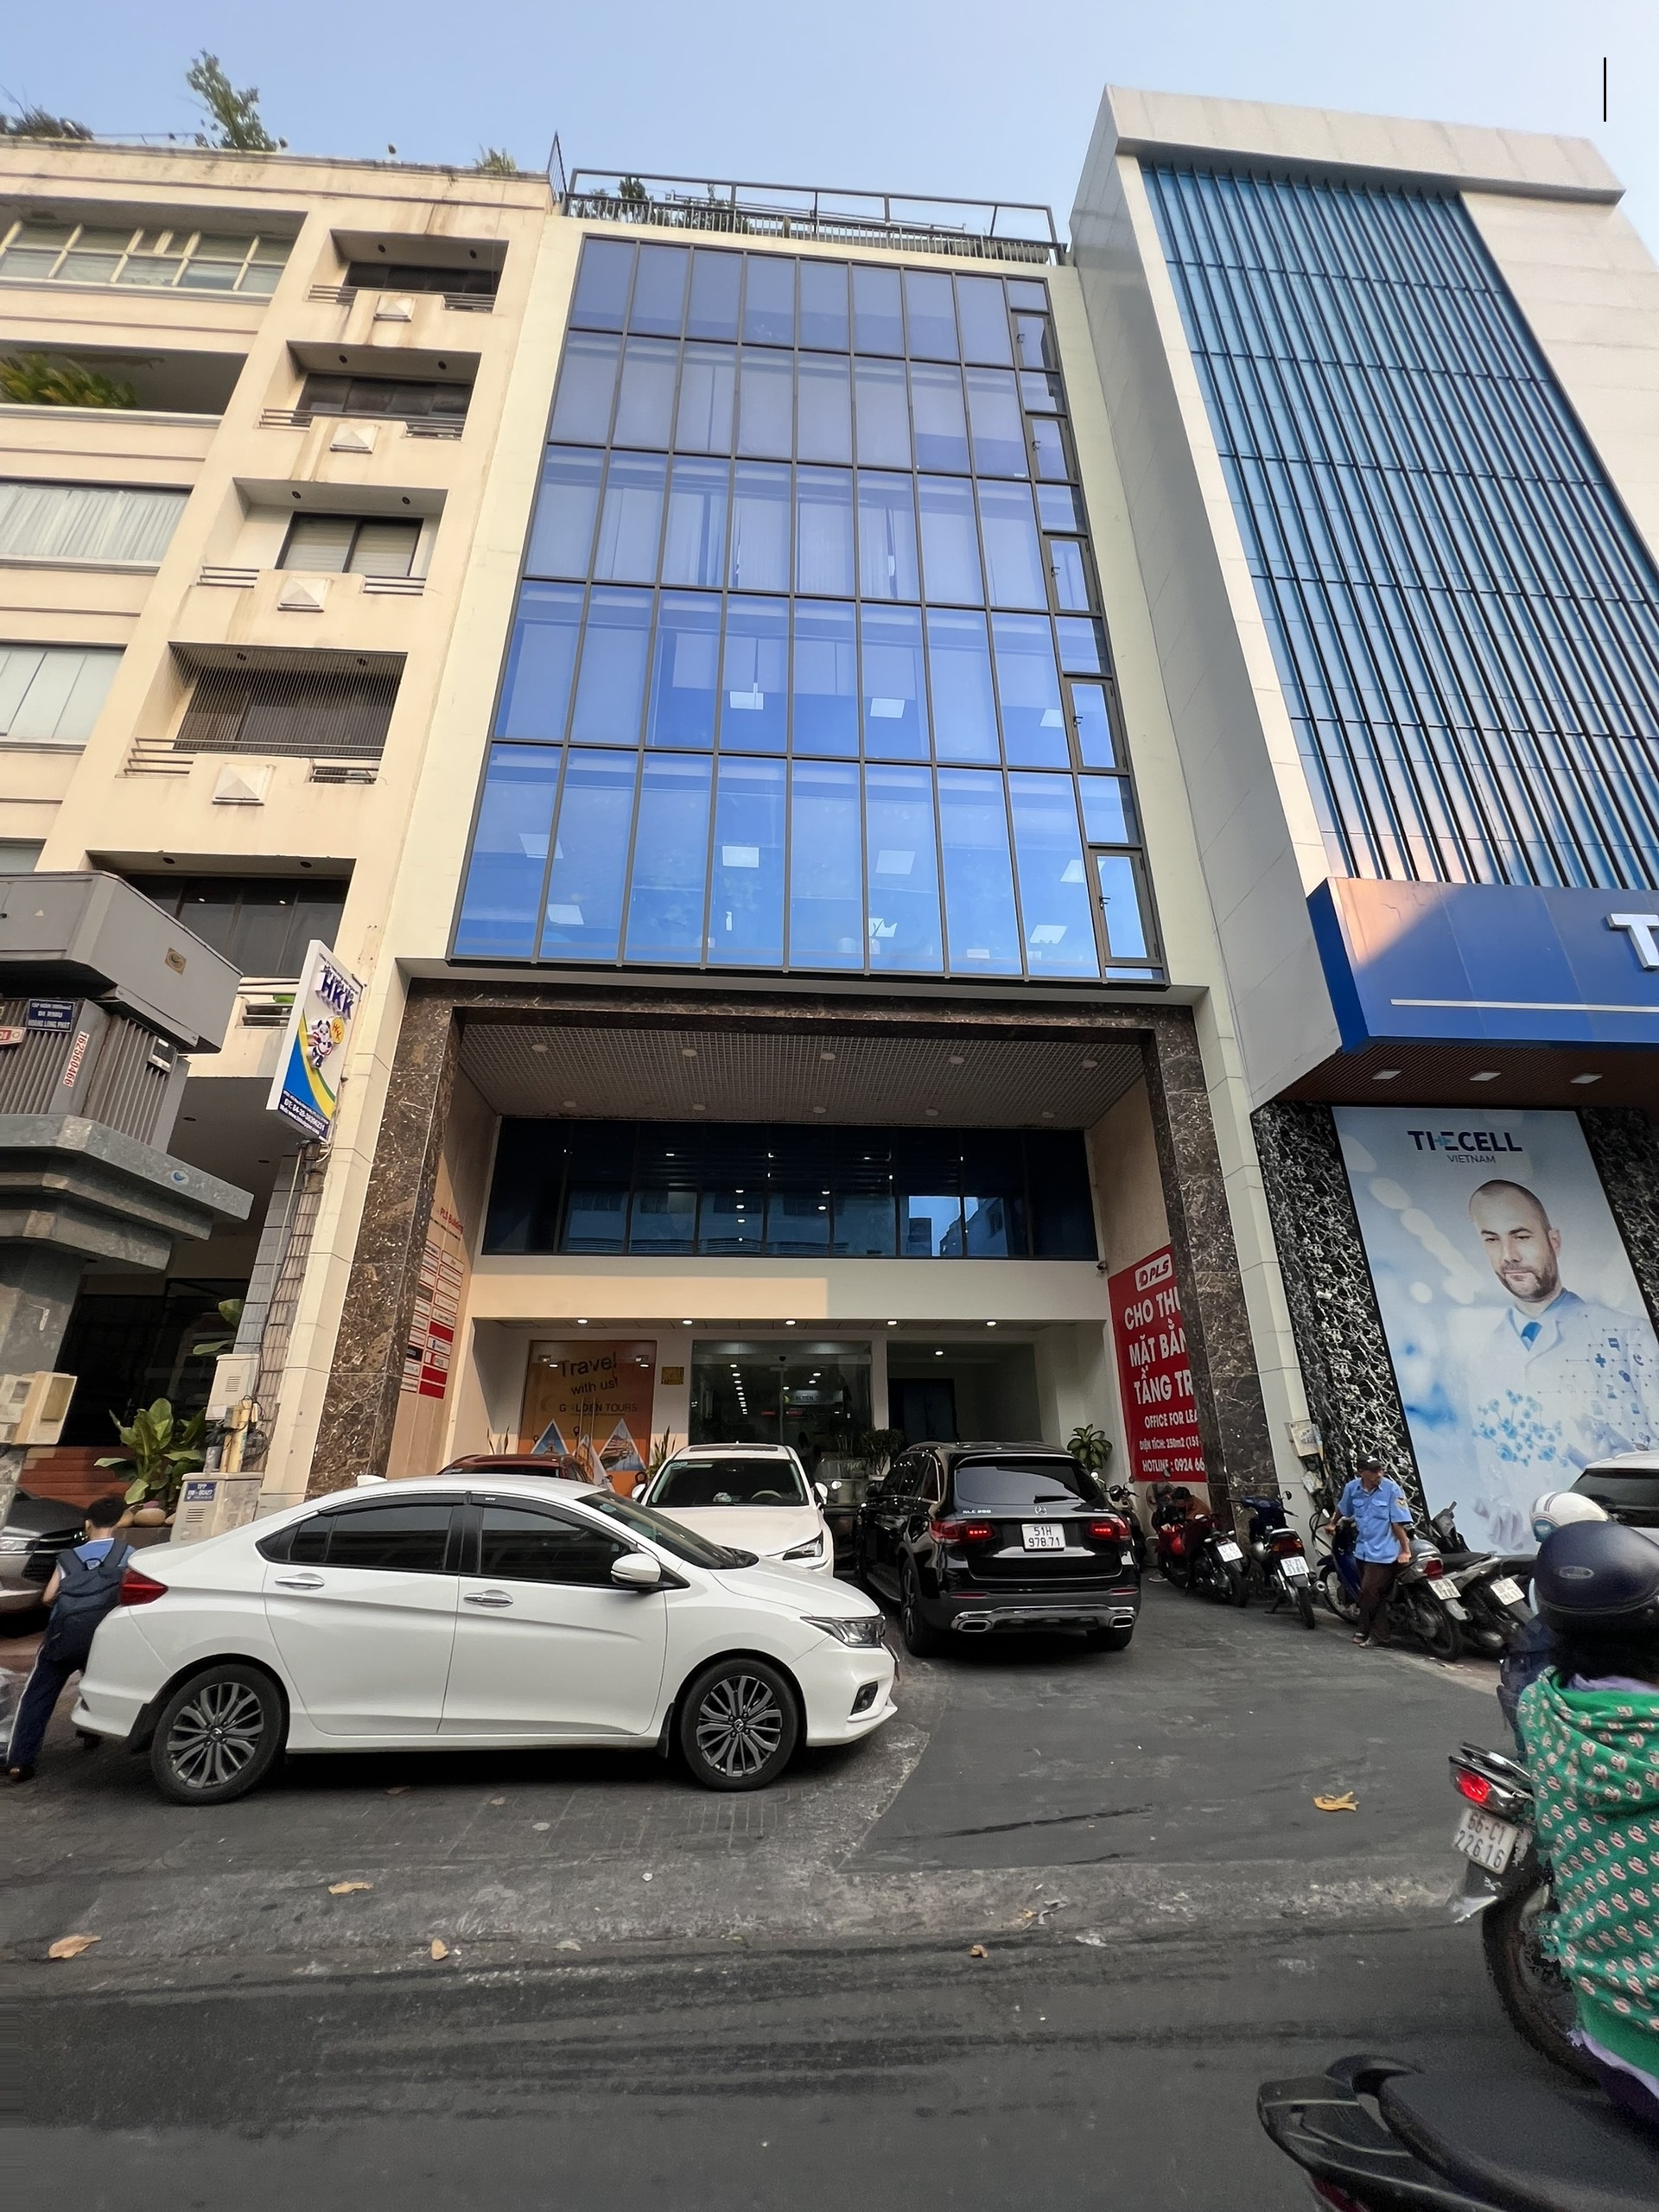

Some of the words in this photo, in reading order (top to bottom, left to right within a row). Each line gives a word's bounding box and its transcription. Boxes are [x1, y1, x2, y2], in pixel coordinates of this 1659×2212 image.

[321, 968, 354, 1020] HKK
[1446, 1154, 1496, 1164] VIETNAM
[1124, 1299, 1154, 1331] CHO
[557, 1351, 617, 1377] Travel
[570, 1381, 596, 1395] with
[559, 1403, 602, 1413] GLDEN
[606, 1402, 638, 1412] TOURS
[1144, 1413, 1168, 1429] OFFICE
[1168, 1410, 1185, 1426] FOR
[1141, 1459, 1168, 1472] HOTLINE
[1174, 1458, 1193, 1471] 0924
[1034, 1526, 1052, 1536] 51H
[1028, 1536, 1060, 1548] 978.71
